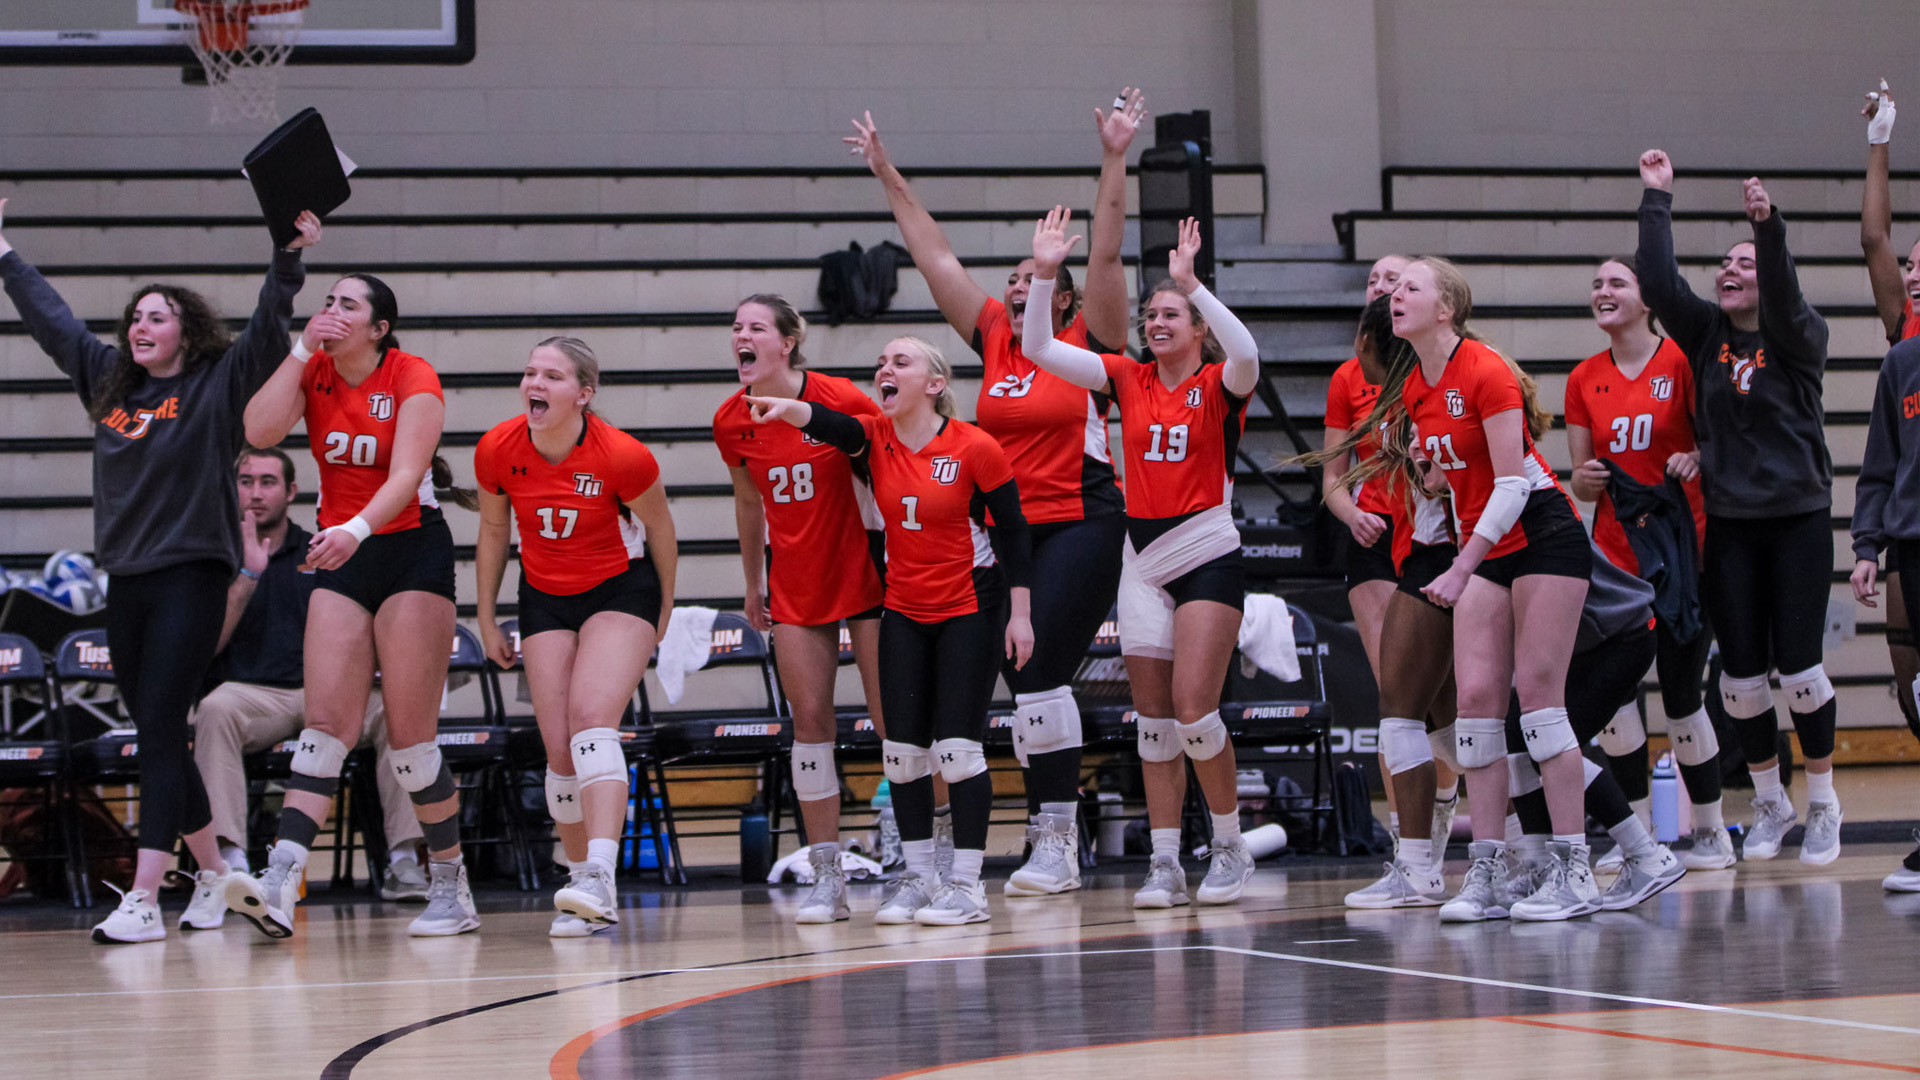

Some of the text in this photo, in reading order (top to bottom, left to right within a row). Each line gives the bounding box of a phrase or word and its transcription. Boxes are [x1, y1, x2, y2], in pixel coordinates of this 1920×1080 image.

[1444, 389, 1466, 419] TU
[1649, 375, 1674, 402] TU
[368, 392, 394, 422] TU
[324, 430, 378, 466] 20
[1143, 424, 1189, 462] 19
[1609, 413, 1653, 453] 30
[1425, 433, 1468, 471] 21
[573, 472, 603, 498] TU
[767, 462, 815, 503] 28
[930, 455, 961, 486] TU
[536, 507, 579, 540] 17
[900, 495, 923, 531] 1
